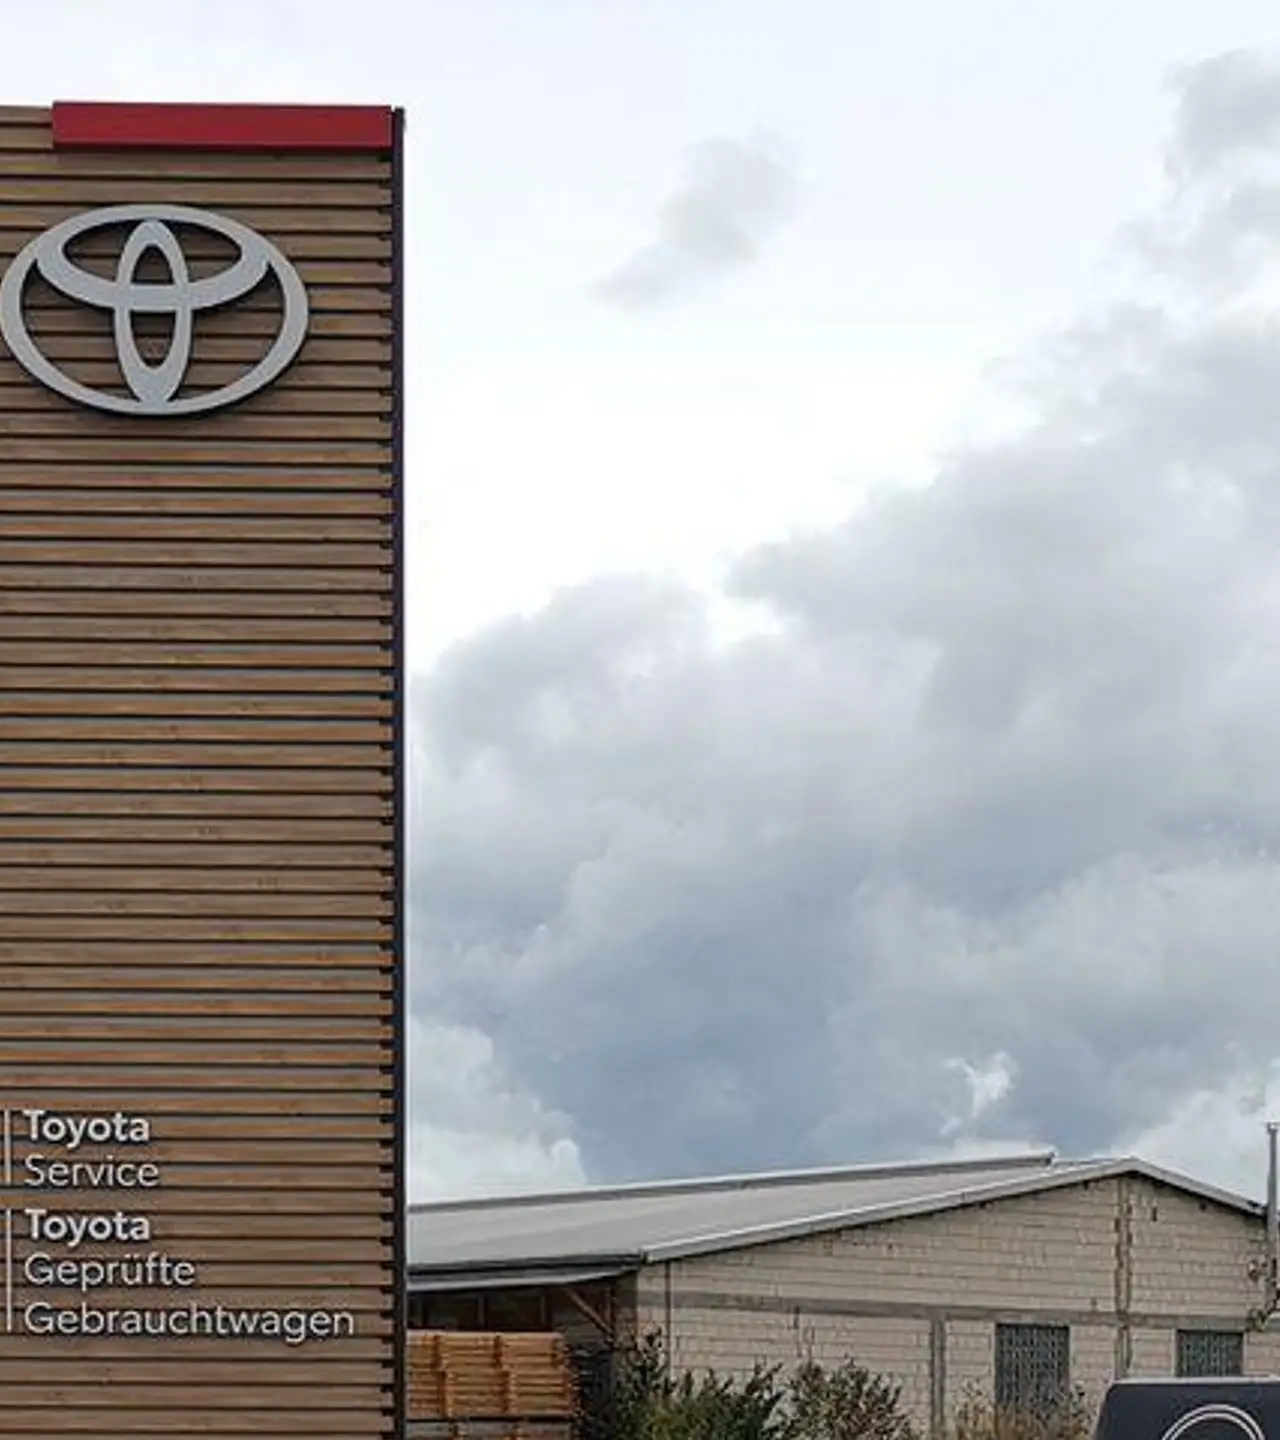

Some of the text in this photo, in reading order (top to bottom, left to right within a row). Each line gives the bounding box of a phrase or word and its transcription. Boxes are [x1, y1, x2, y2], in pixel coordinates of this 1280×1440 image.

[23, 1108, 150, 1148] Toyota
[24, 1154, 159, 1188] Service
[24, 1208, 151, 1248] Toyota
[24, 1252, 196, 1291] Geprüfte
[24, 1302, 354, 1343] Gebrauchtwagen
